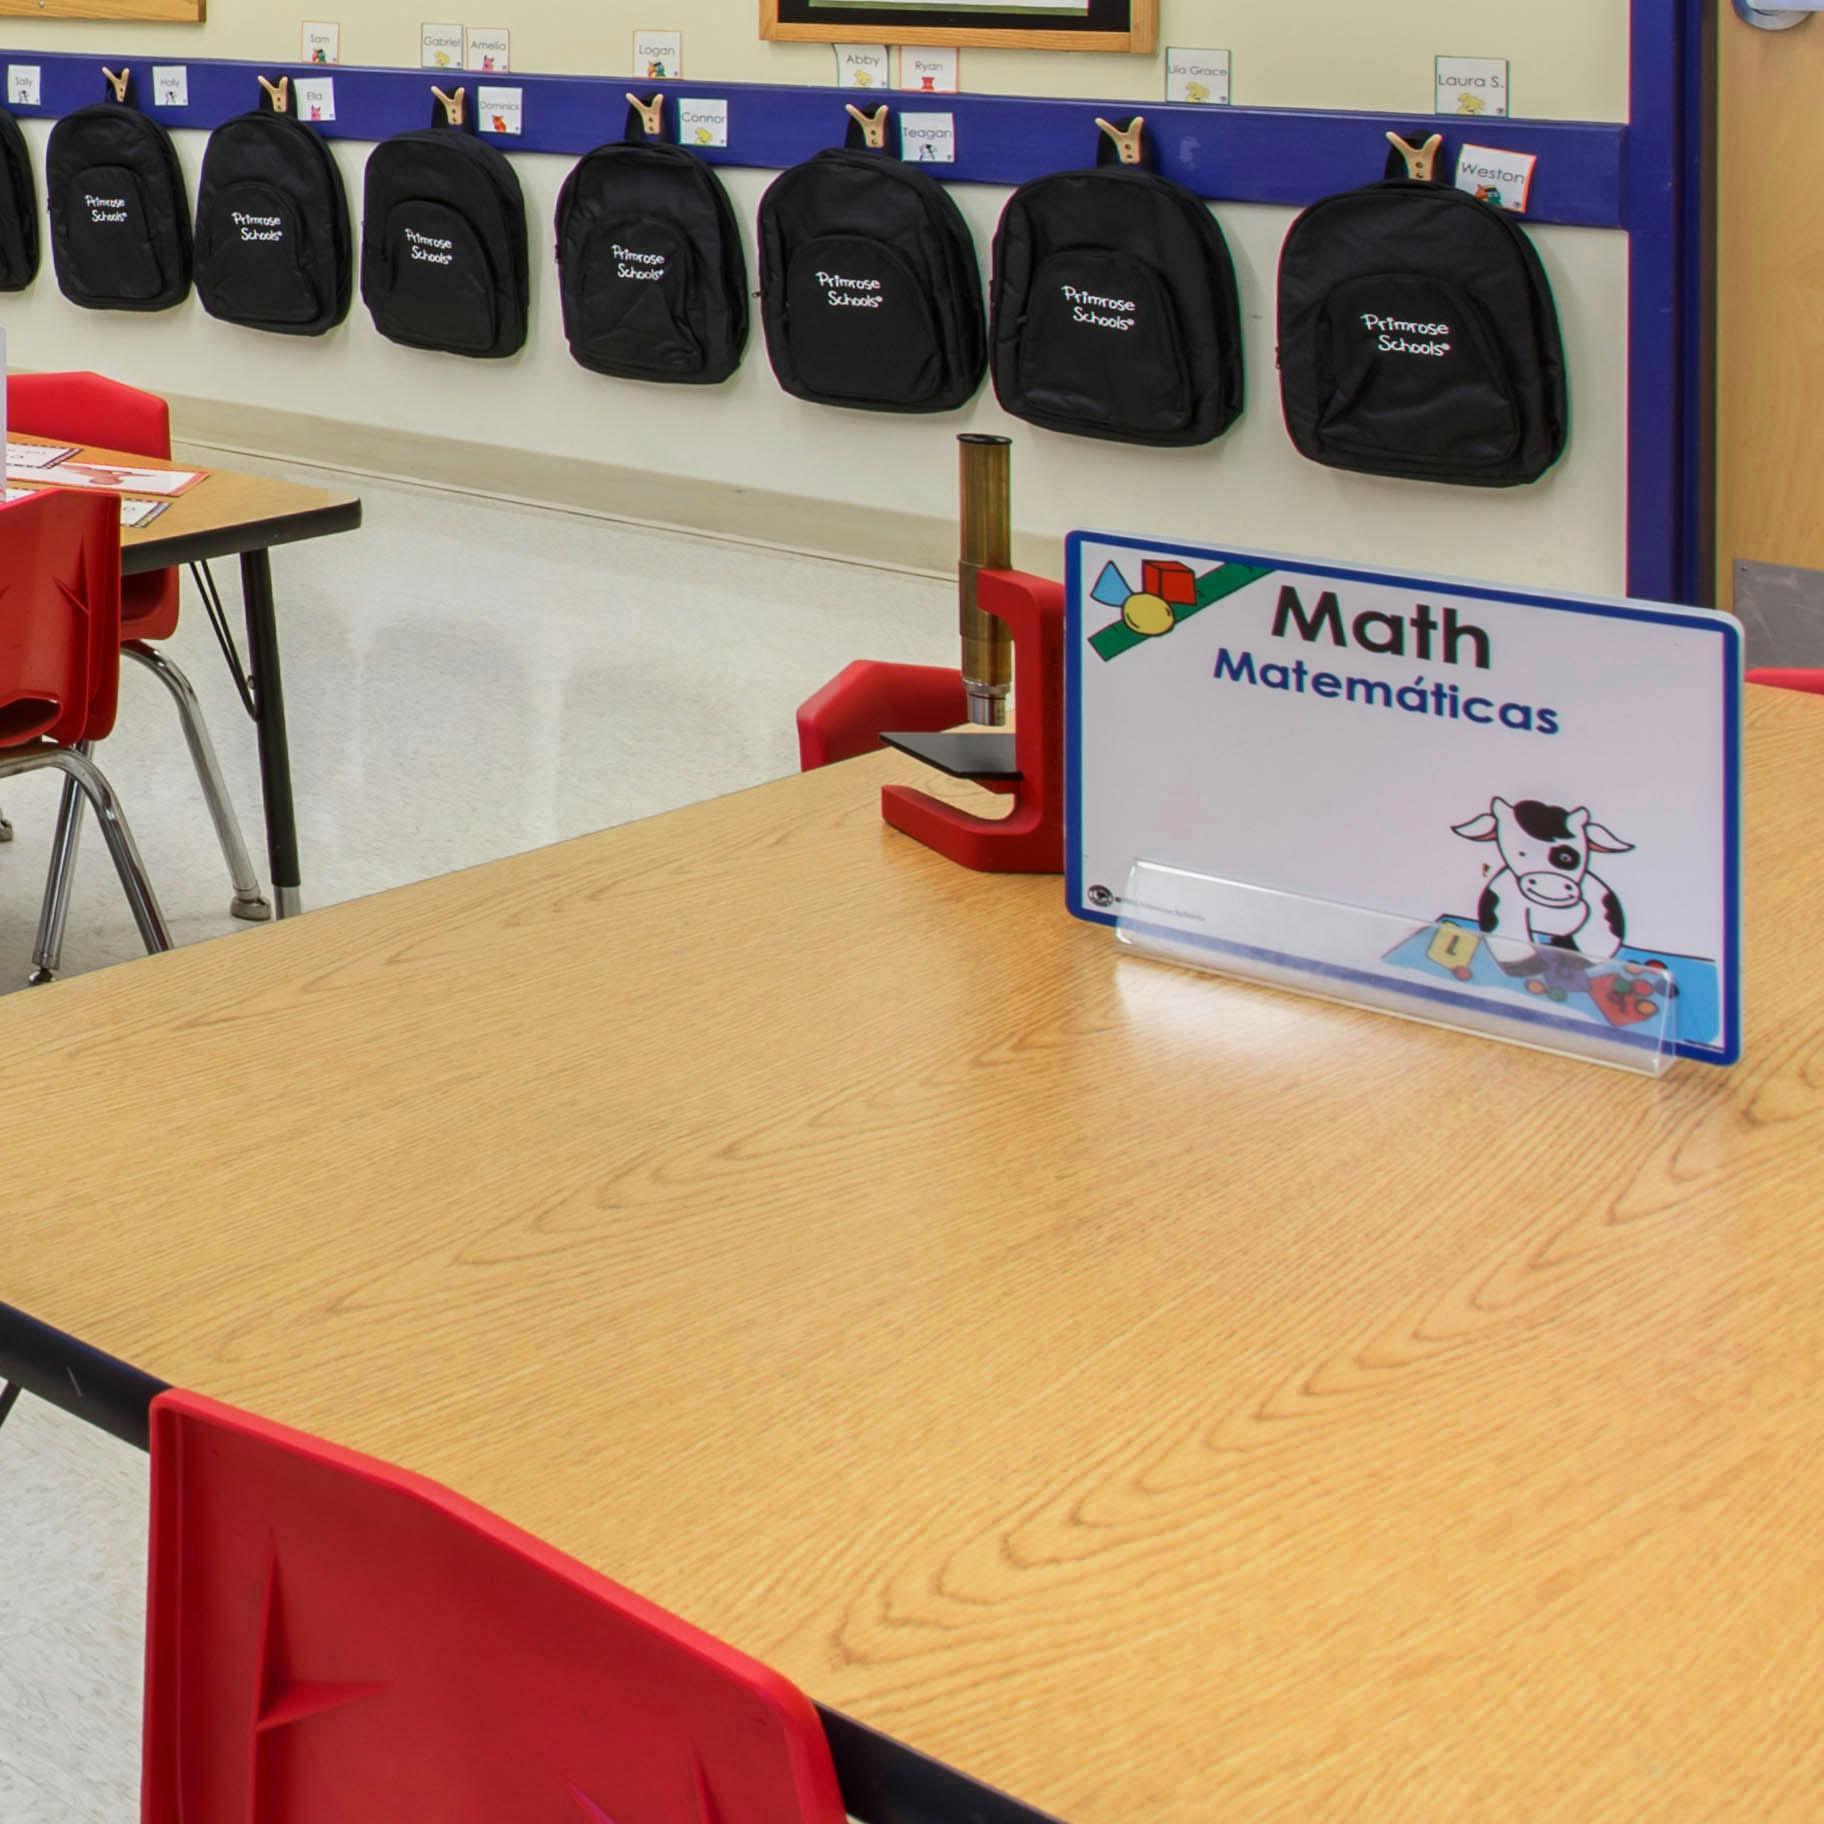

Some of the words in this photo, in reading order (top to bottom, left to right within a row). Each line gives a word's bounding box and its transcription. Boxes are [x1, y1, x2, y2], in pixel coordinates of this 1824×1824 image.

[423, 35, 462, 48] Gabriel
[470, 40, 507, 51] Amelia
[638, 44, 676, 58] Logan
[845, 54, 881, 68] Abby
[914, 60, 944, 74] Ryan
[1190, 65, 1229, 77] Grace
[1438, 74, 1486, 87] Laura
[1491, 74, 1505, 88] S.
[306, 90, 323, 101] Ella
[681, 111, 728, 124] Connor
[903, 126, 952, 142] Teagan
[1461, 161, 1526, 184] Weston
[85, 195, 125, 207] Primrose
[231, 212, 281, 226] Primrose
[405, 228, 452, 249] Primrose
[611, 244, 665, 265] Primrose
[816, 271, 881, 289] Primrose
[1061, 286, 1136, 312] Primrose
[1361, 313, 1449, 336] Primrose
[1271, 584, 1491, 670] Math
[1213, 647, 1560, 736] Matemáticas
